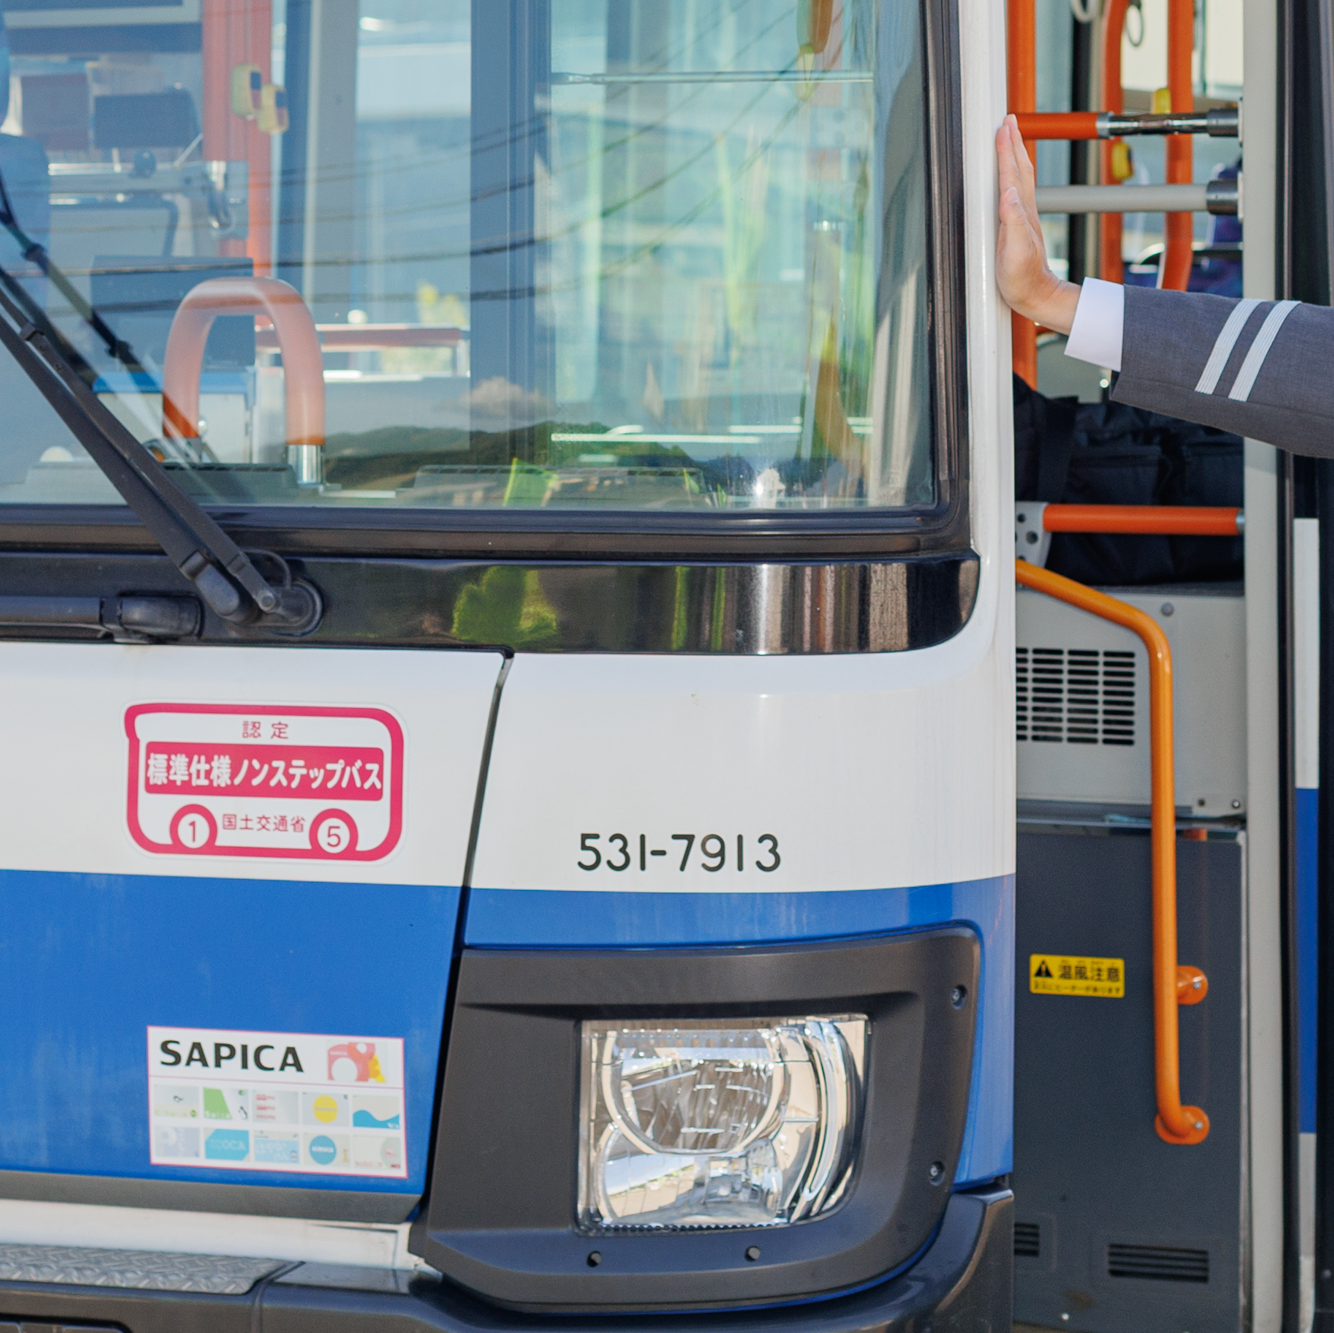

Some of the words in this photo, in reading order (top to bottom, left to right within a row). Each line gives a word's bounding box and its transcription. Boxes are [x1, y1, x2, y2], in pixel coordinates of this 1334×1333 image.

[242, 720, 289, 740] 認定
[147, 752, 383, 791] 標準仕様ノンステップバス
[188, 820, 197, 842] 1
[222, 813, 306, 834] 国土交通省
[326, 825, 341, 847] 5
[577, 833, 781, 872] 531-7913
[159, 1039, 305, 1074] SAPICA
